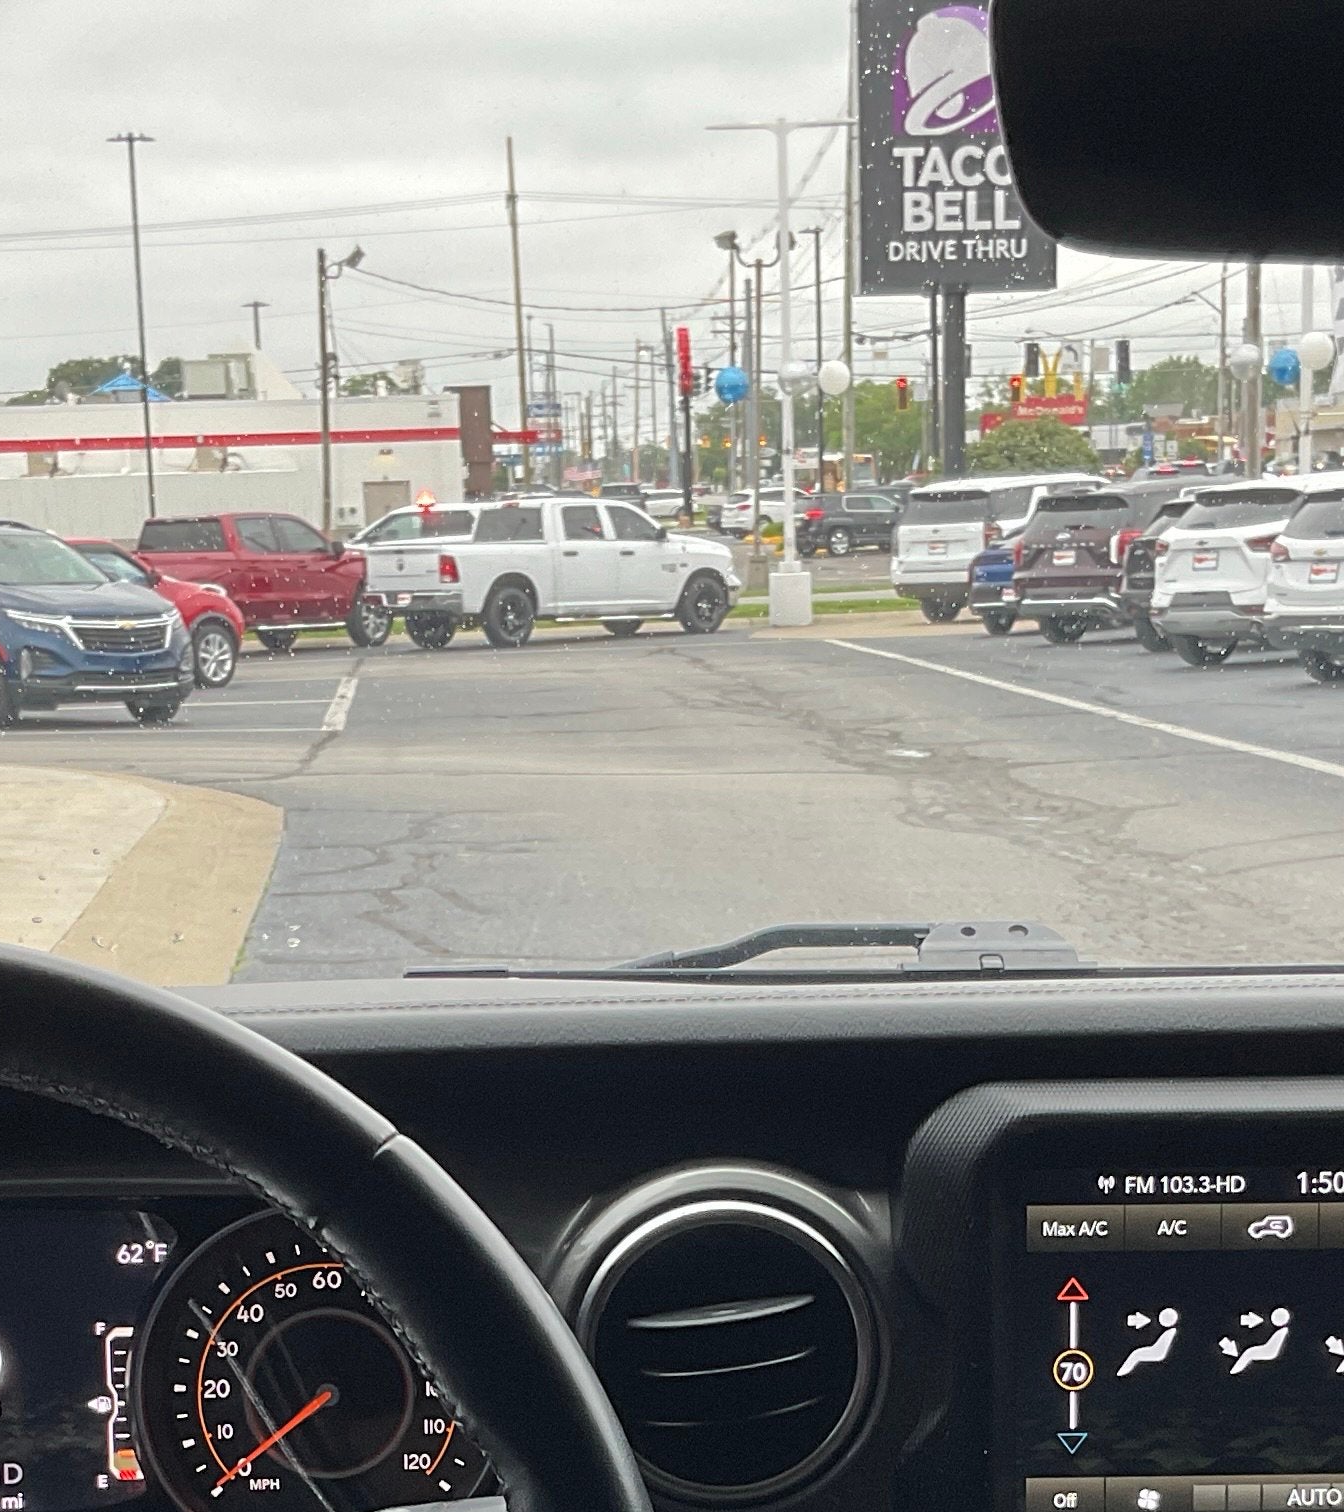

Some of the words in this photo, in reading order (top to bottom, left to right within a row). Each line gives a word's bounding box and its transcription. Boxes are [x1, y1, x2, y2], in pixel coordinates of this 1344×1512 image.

[892, 145, 1012, 187] TACO
[903, 190, 1021, 232] BELL
[888, 240, 956, 261] DRIVE
[963, 238, 1028, 260] THRU
[1125, 1176, 1155, 1194] FM
[1160, 1175, 1246, 1194] 103.3-HD
[1042, 1221, 1075, 1237] Max
[1078, 1220, 1109, 1237] A/C
[1157, 1219, 1187, 1236] A/C
[312, 1270, 342, 1290] 60
[274, 1283, 297, 1299] 50
[236, 1303, 264, 1323] 40
[95, 1322, 106, 1336] F
[217, 1341, 238, 1357] 30
[1060, 1362, 1087, 1382] 70
[204, 1379, 231, 1399] 20
[217, 1425, 233, 1440] 10
[423, 1418, 446, 1435] 110
[403, 1453, 431, 1470] 120
[97, 1475, 108, 1489] E
[249, 1478, 280, 1491] MPH
[1, 1493, 24, 1510] mi
[1053, 1493, 1078, 1509] Off
[1286, 1488, 1343, 1507] AUTO
